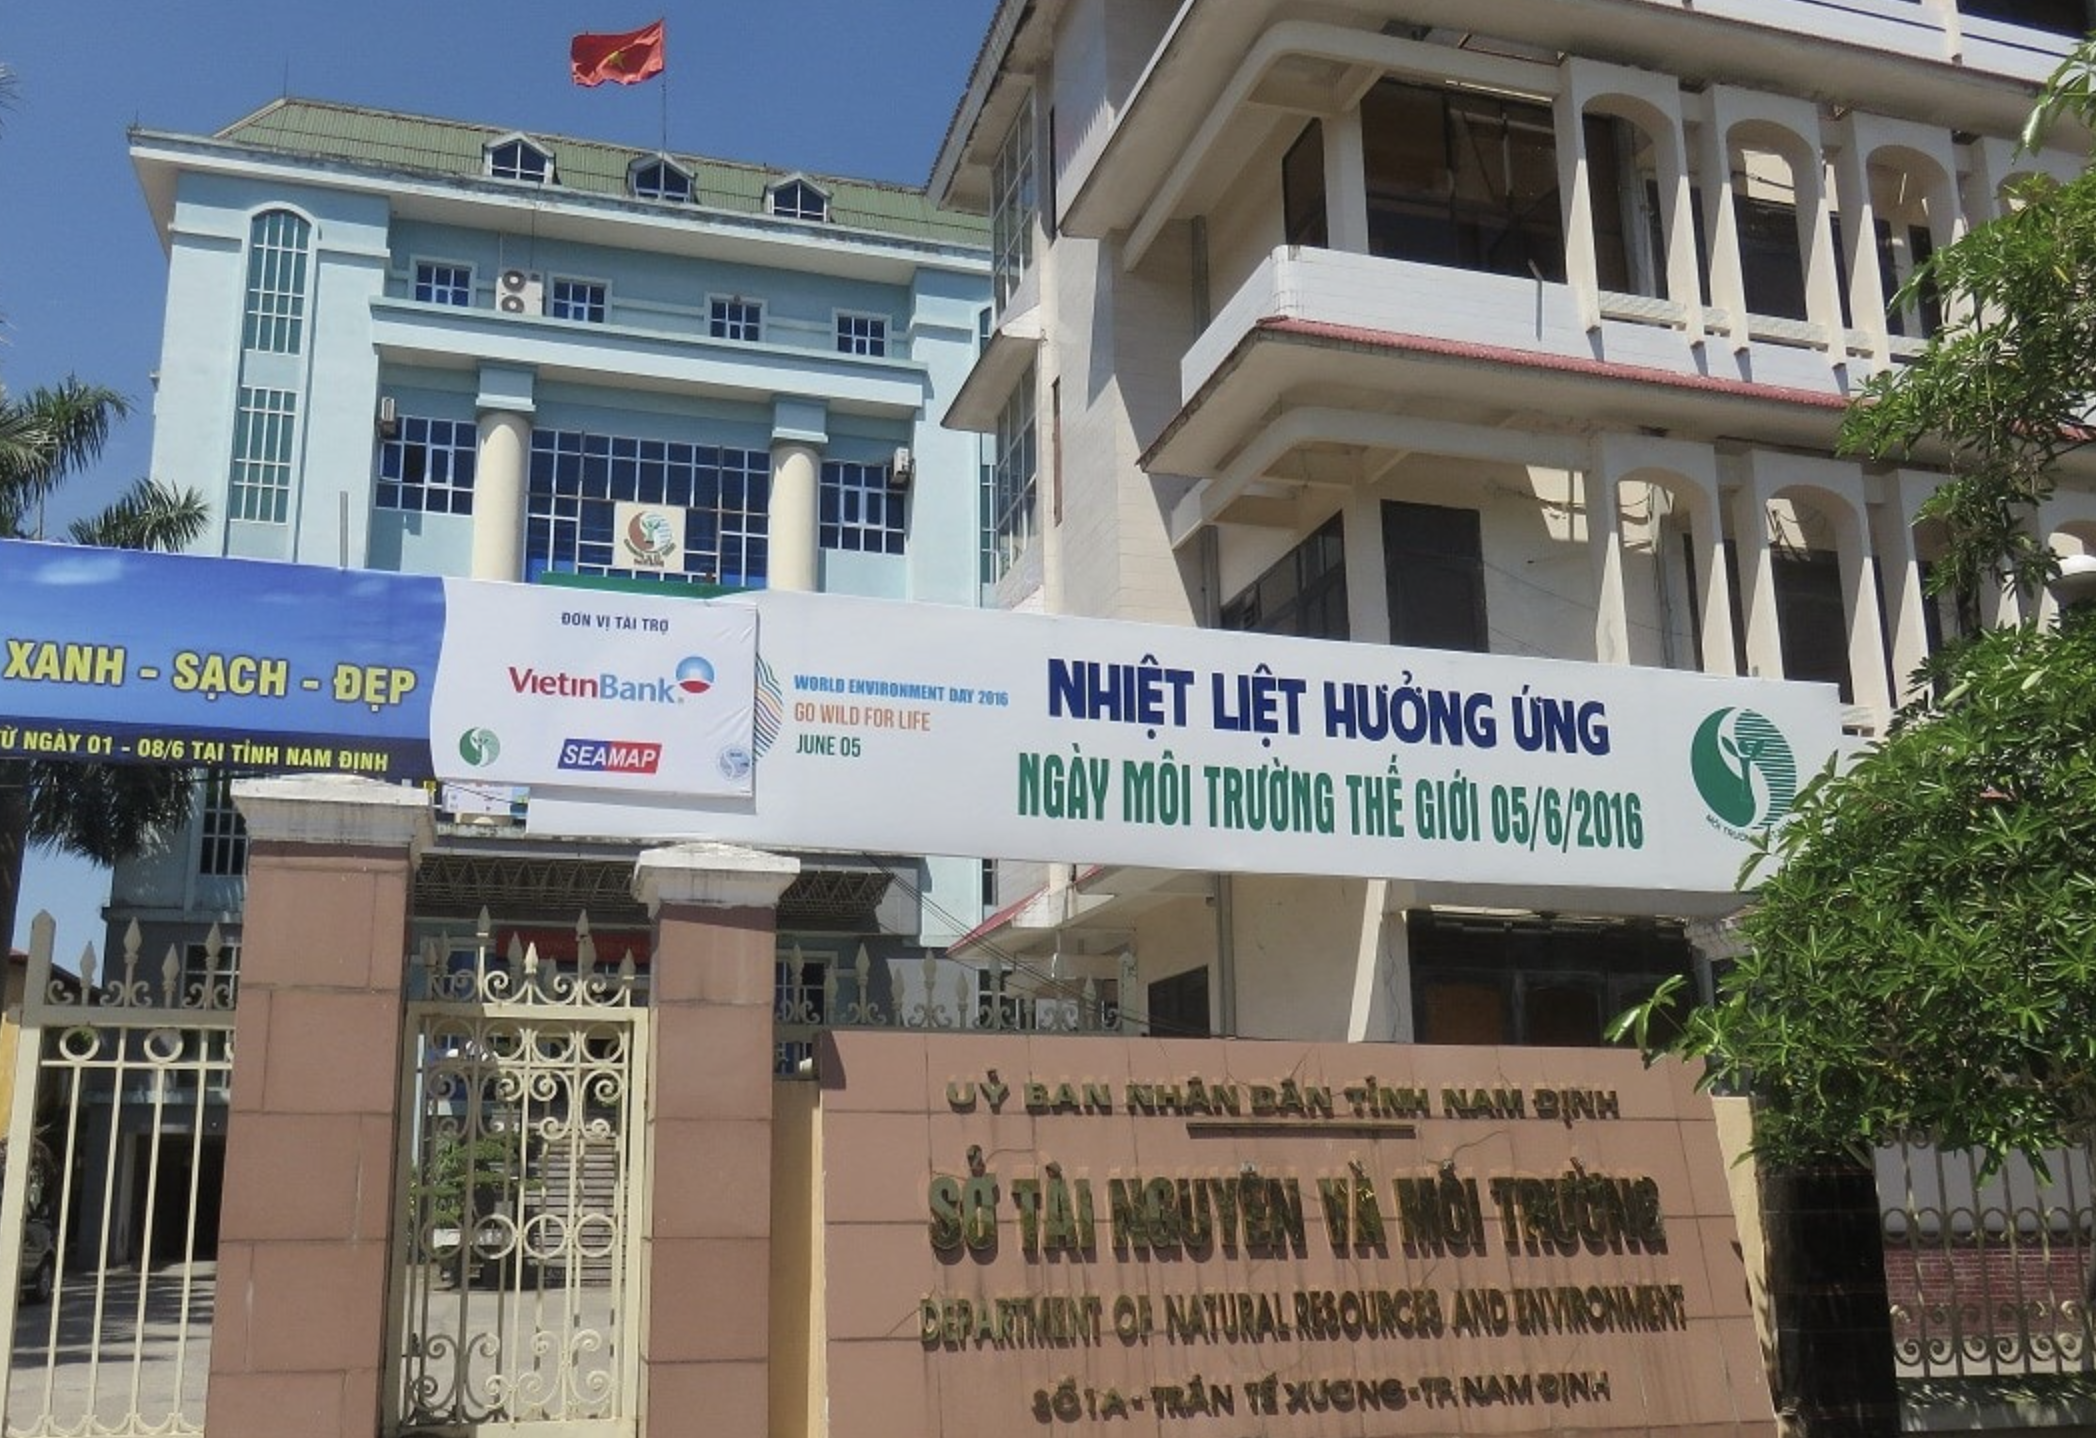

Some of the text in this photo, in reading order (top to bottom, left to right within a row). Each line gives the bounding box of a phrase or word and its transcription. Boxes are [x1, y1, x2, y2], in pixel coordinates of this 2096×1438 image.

[596, 614, 611, 632] VỊ
[615, 615, 637, 630] TÀI
[642, 618, 669, 635] TRỢ
[3, 638, 127, 686] XANH
[170, 650, 289, 700] SẠCH
[333, 663, 418, 713] ĐẸP
[508, 666, 676, 704] VietinBank
[794, 675, 1009, 707] WORLD ENVIRONMENT DAY 2016
[795, 703, 931, 731] GO WILD FOR LIFE
[1047, 653, 1611, 756] NHIỆT LIỆT HƯỞNG ỨNG
[0, 725, 19, 750] Ừ
[23, 728, 80, 752] NGÀY
[87, 736, 112, 754] 01
[137, 738, 184, 760] 08/6
[192, 741, 223, 765] TẠI
[231, 740, 279, 764] TỈNH
[286, 747, 331, 768] NAM
[338, 750, 389, 774] ĐỊNH
[563, 744, 656, 768] SEAMAP
[796, 735, 861, 757] JUNE 05
[1018, 743, 1644, 853] NGÀY MÔI TRƯỜNG THẾ GIỚI 05/6/2016
[1023, 1082, 1112, 1115] BAN
[1126, 1076, 1240, 1117] NHÂN
[1249, 1078, 1333, 1118] DÂN
[1344, 1075, 1431, 1118] TỈNH
[1441, 1088, 1526, 1119] NAM
[1533, 1089, 1620, 1129] ĐỊNH
[927, 1145, 1669, 1265] SỞ TÀI NGUYÊN VÀ MÔI TRƯỜNG
[920, 1284, 1687, 1351] DEPARTMENT OF NATURAL RESOURCES AND ENVIRONMENT
[1459, 1374, 1534, 1408] NAM
[1535, 1370, 1611, 1409] ĐỊNH
